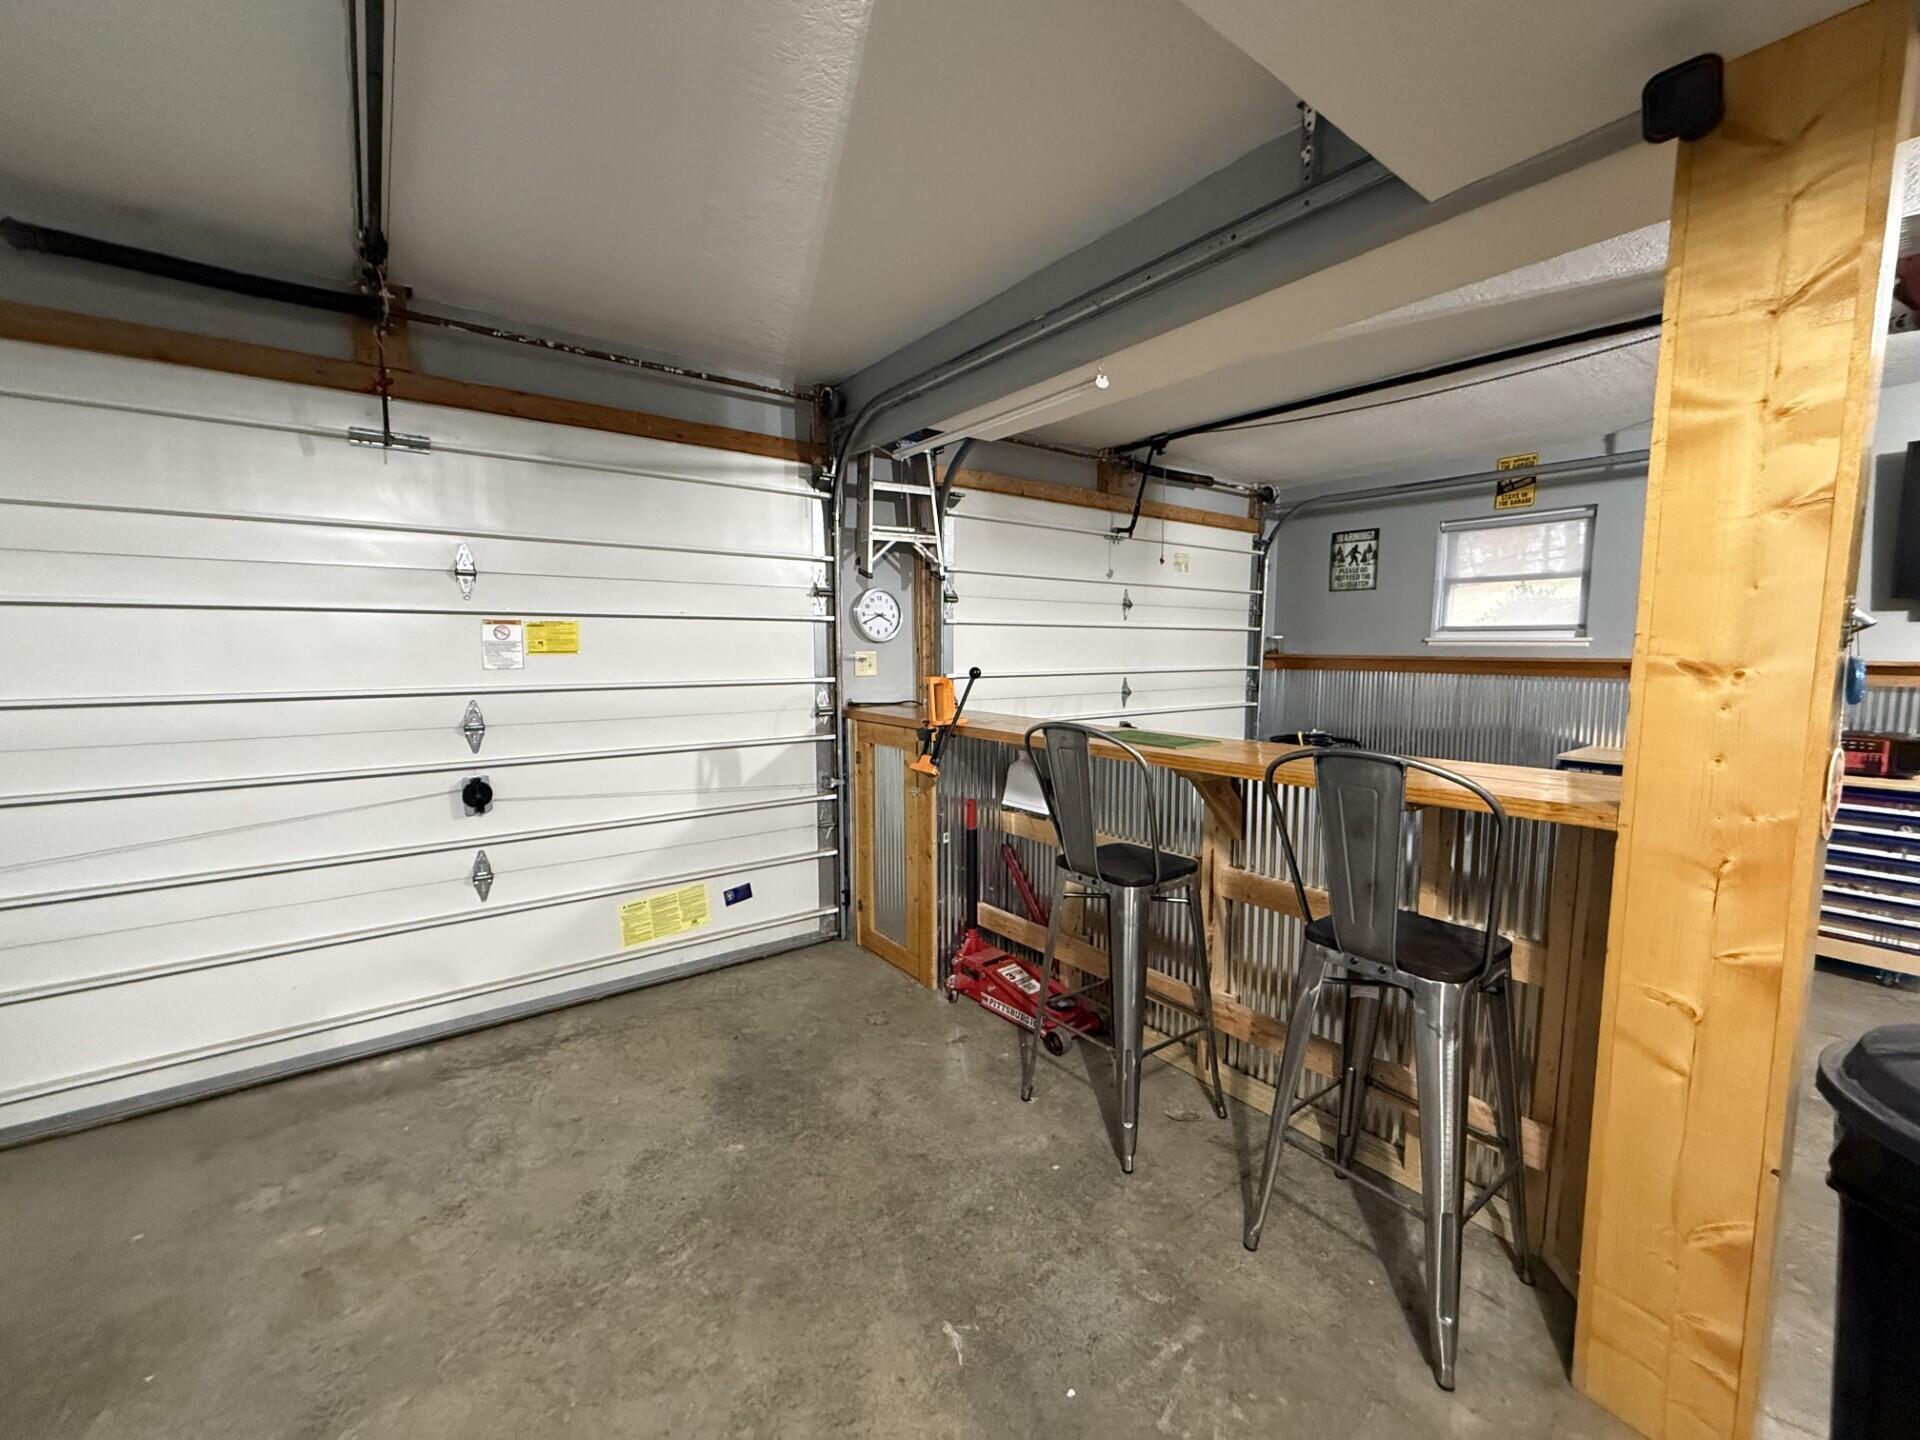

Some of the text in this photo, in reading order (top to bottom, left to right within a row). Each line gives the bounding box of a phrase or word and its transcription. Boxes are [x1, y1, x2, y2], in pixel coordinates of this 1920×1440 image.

[1498, 497, 1532, 507] THE GARAGE
[1336, 531, 1375, 543] WARNING!
